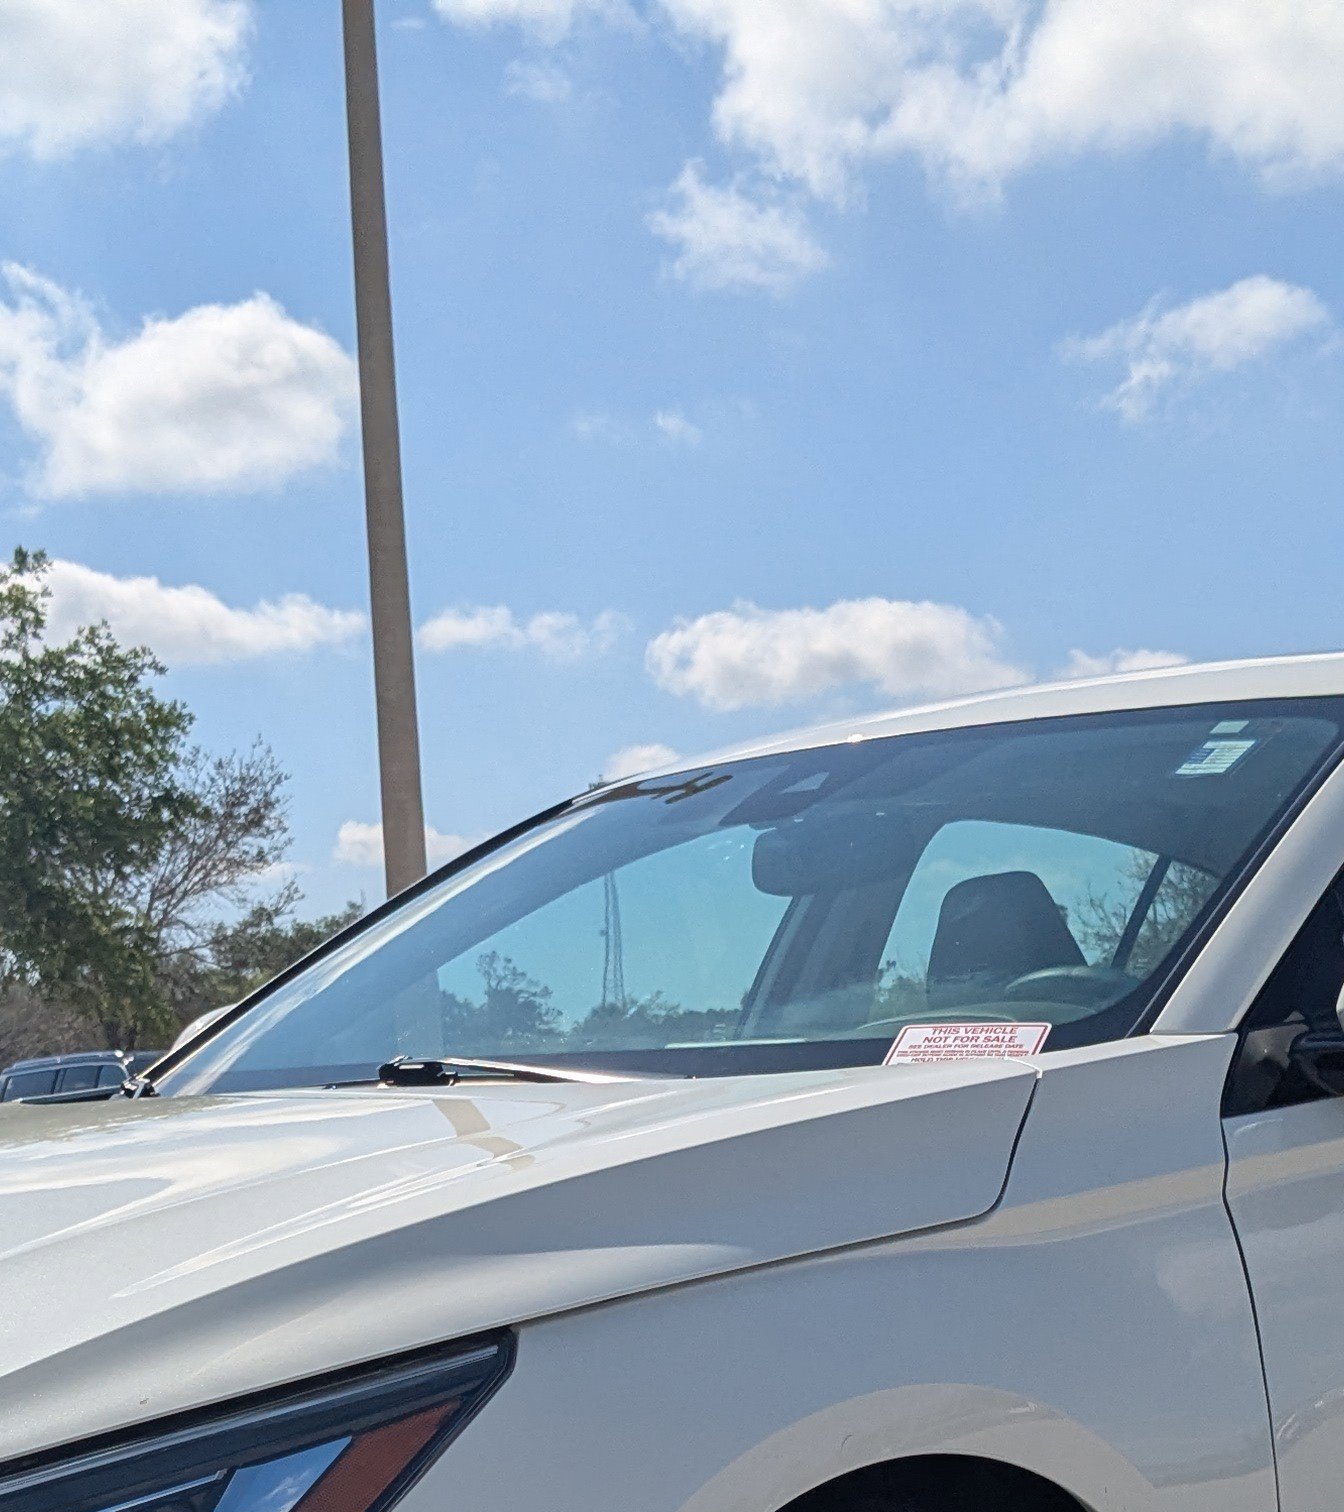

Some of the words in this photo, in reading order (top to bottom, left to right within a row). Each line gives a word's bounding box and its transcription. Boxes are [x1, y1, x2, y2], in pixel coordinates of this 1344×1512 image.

[932, 1027, 960, 1035] THIS
[952, 1035, 980, 1043] FOR
[983, 1035, 1017, 1043] SALE
